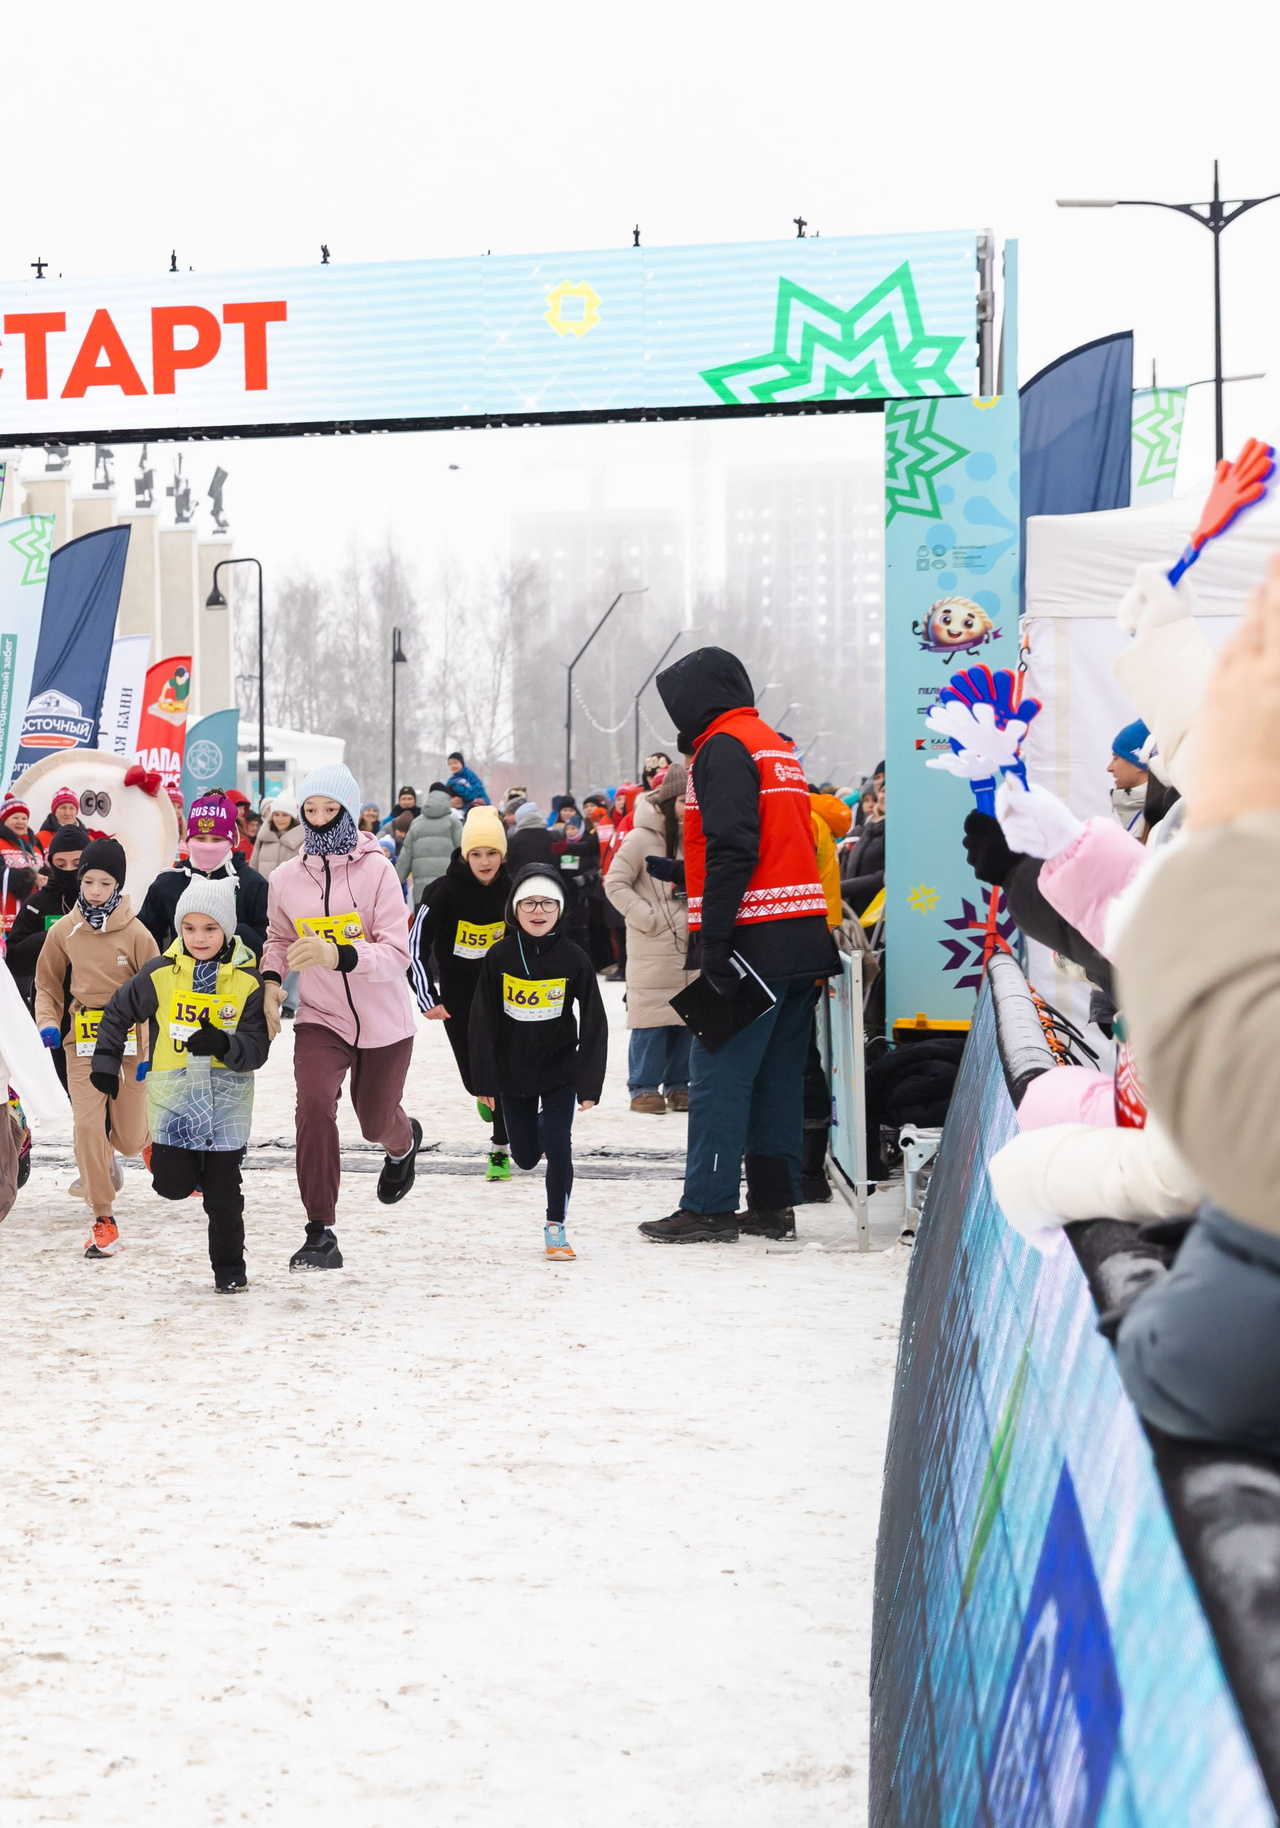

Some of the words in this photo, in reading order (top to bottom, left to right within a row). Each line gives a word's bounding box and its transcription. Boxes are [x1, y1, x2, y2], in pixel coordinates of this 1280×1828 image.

[117, 688, 133, 729] БАНИ
[135, 747, 181, 772] ПАПА
[190, 806, 227, 819] RUSSIA
[460, 930, 487, 946] 155
[507, 986, 539, 1006] 166
[175, 1003, 210, 1023] 154
